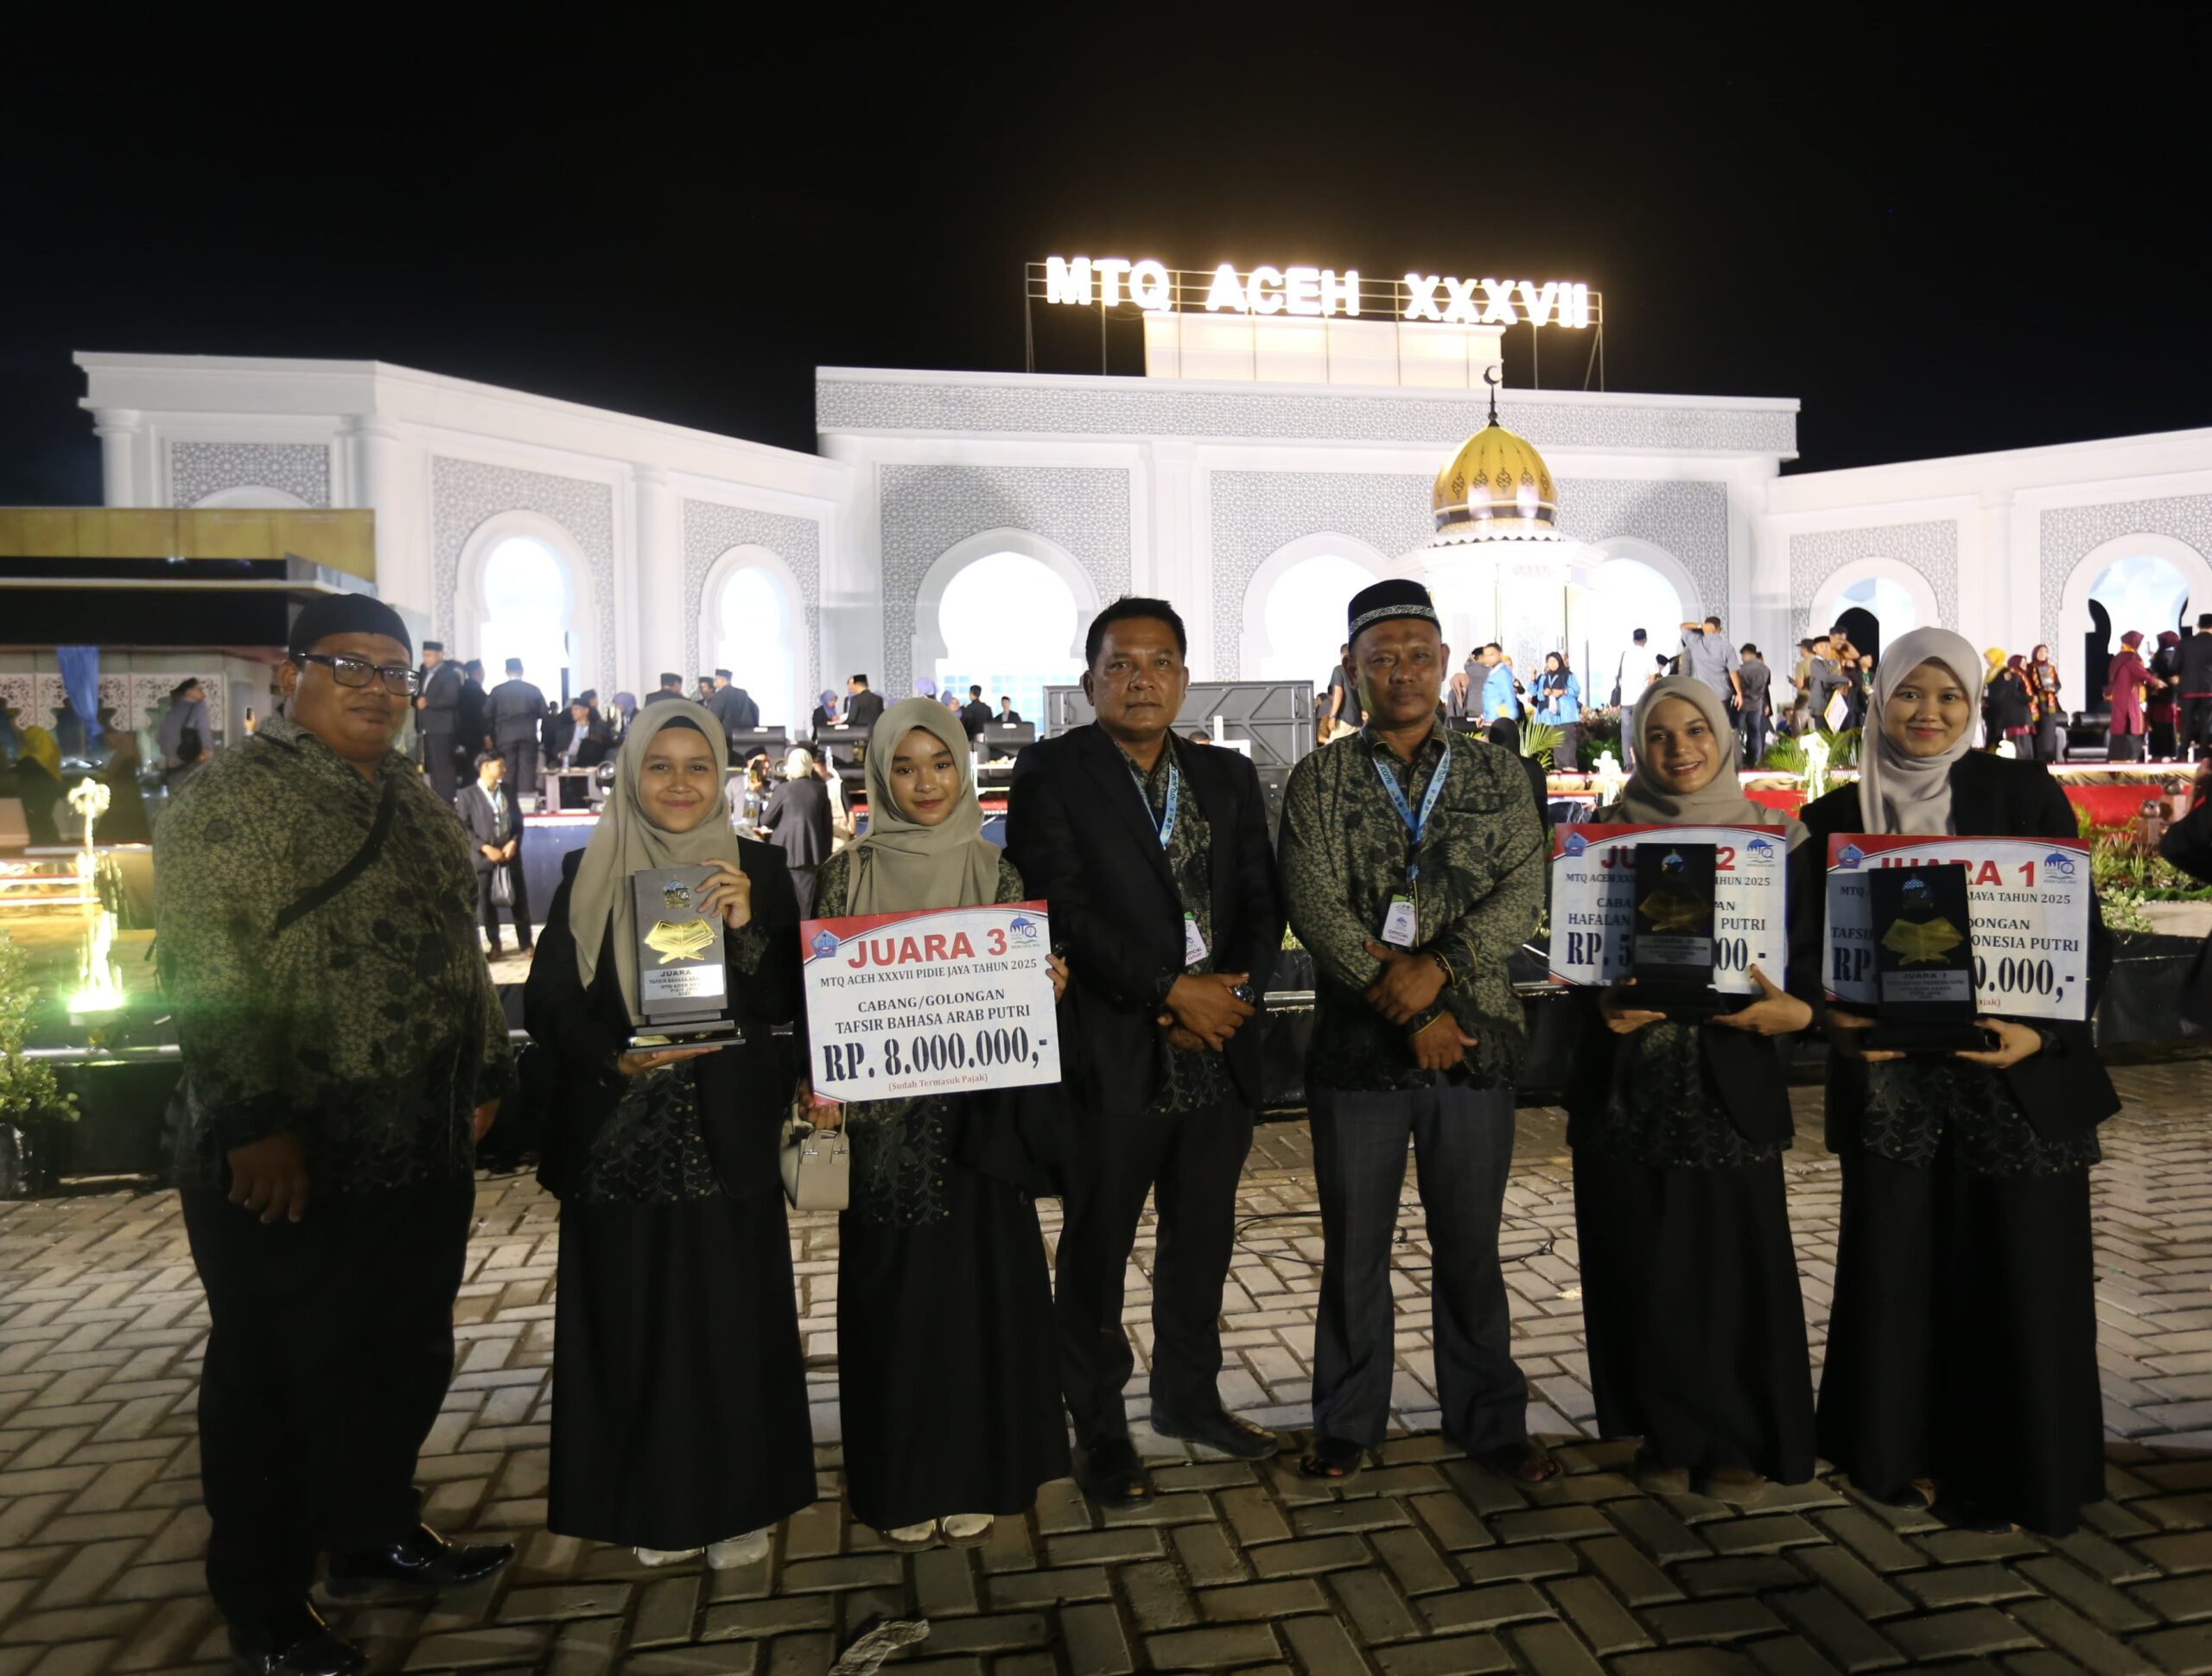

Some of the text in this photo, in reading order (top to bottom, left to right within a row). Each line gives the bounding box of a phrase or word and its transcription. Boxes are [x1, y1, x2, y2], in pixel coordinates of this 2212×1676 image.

[1046, 256, 1588, 329] MTQ ACEH XXXVII
[1715, 847, 1735, 871] 2
[1567, 873, 1587, 884] MTQ
[1715, 876, 1742, 886] HUN
[1745, 877, 1770, 886] 2025
[2018, 860, 2035, 887] 1
[1840, 886, 1865, 898] MTQ
[1998, 892, 2037, 903] TAHUN
[2041, 894, 2071, 905] 2025
[1568, 913, 1766, 930] HAFALAN PUTRI
[848, 928, 1008, 969] JUARA 3
[1567, 932, 1610, 966] RP.
[1971, 934, 2025, 949] ONESIA
[2031, 937, 2080, 951] PUTRI
[820, 958, 1037, 988] MTQ ACEH XXXVII PIDIE JAYA TAHUN 2025
[858, 988, 1005, 1013] CABANG/GOLONGAN
[836, 1004, 1030, 1034] TAFSIR BAHASA ARAB PUTRI
[823, 1026, 1047, 1082] RP. 8.000.000,-
[888, 1073, 988, 1092] (Sudah Termasuk Pajak)
